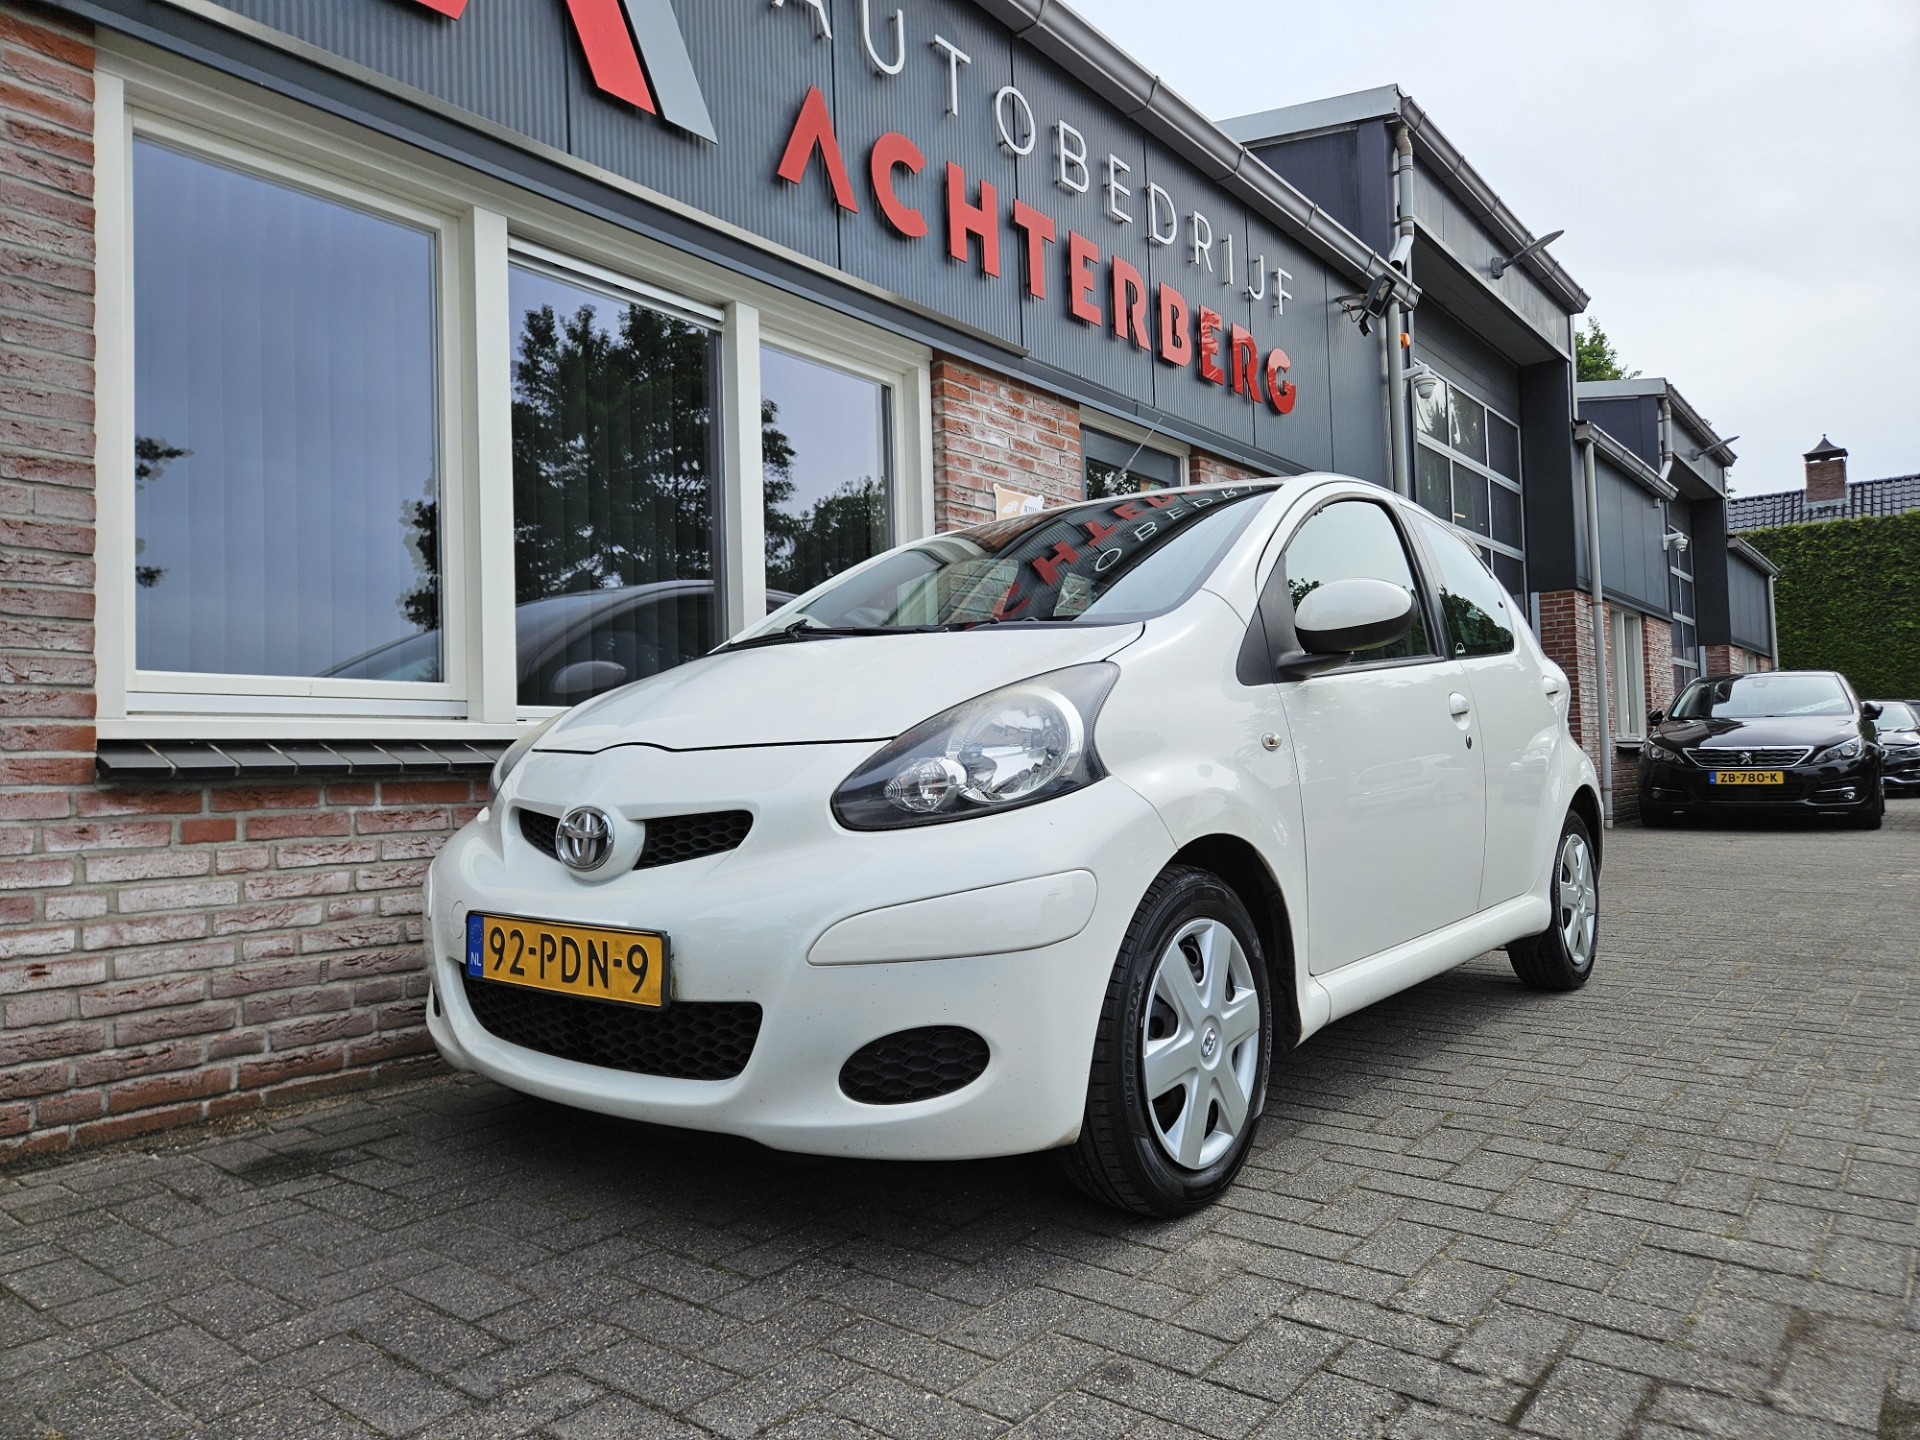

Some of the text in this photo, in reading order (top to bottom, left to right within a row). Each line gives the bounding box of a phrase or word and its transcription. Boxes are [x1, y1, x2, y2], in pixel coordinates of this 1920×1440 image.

[777, 84, 1297, 415] ACHTERBERG
[1720, 772, 1778, 783] ZB-780-K
[470, 951, 482, 967] NL
[488, 926, 649, 994] 92-PDN-9
